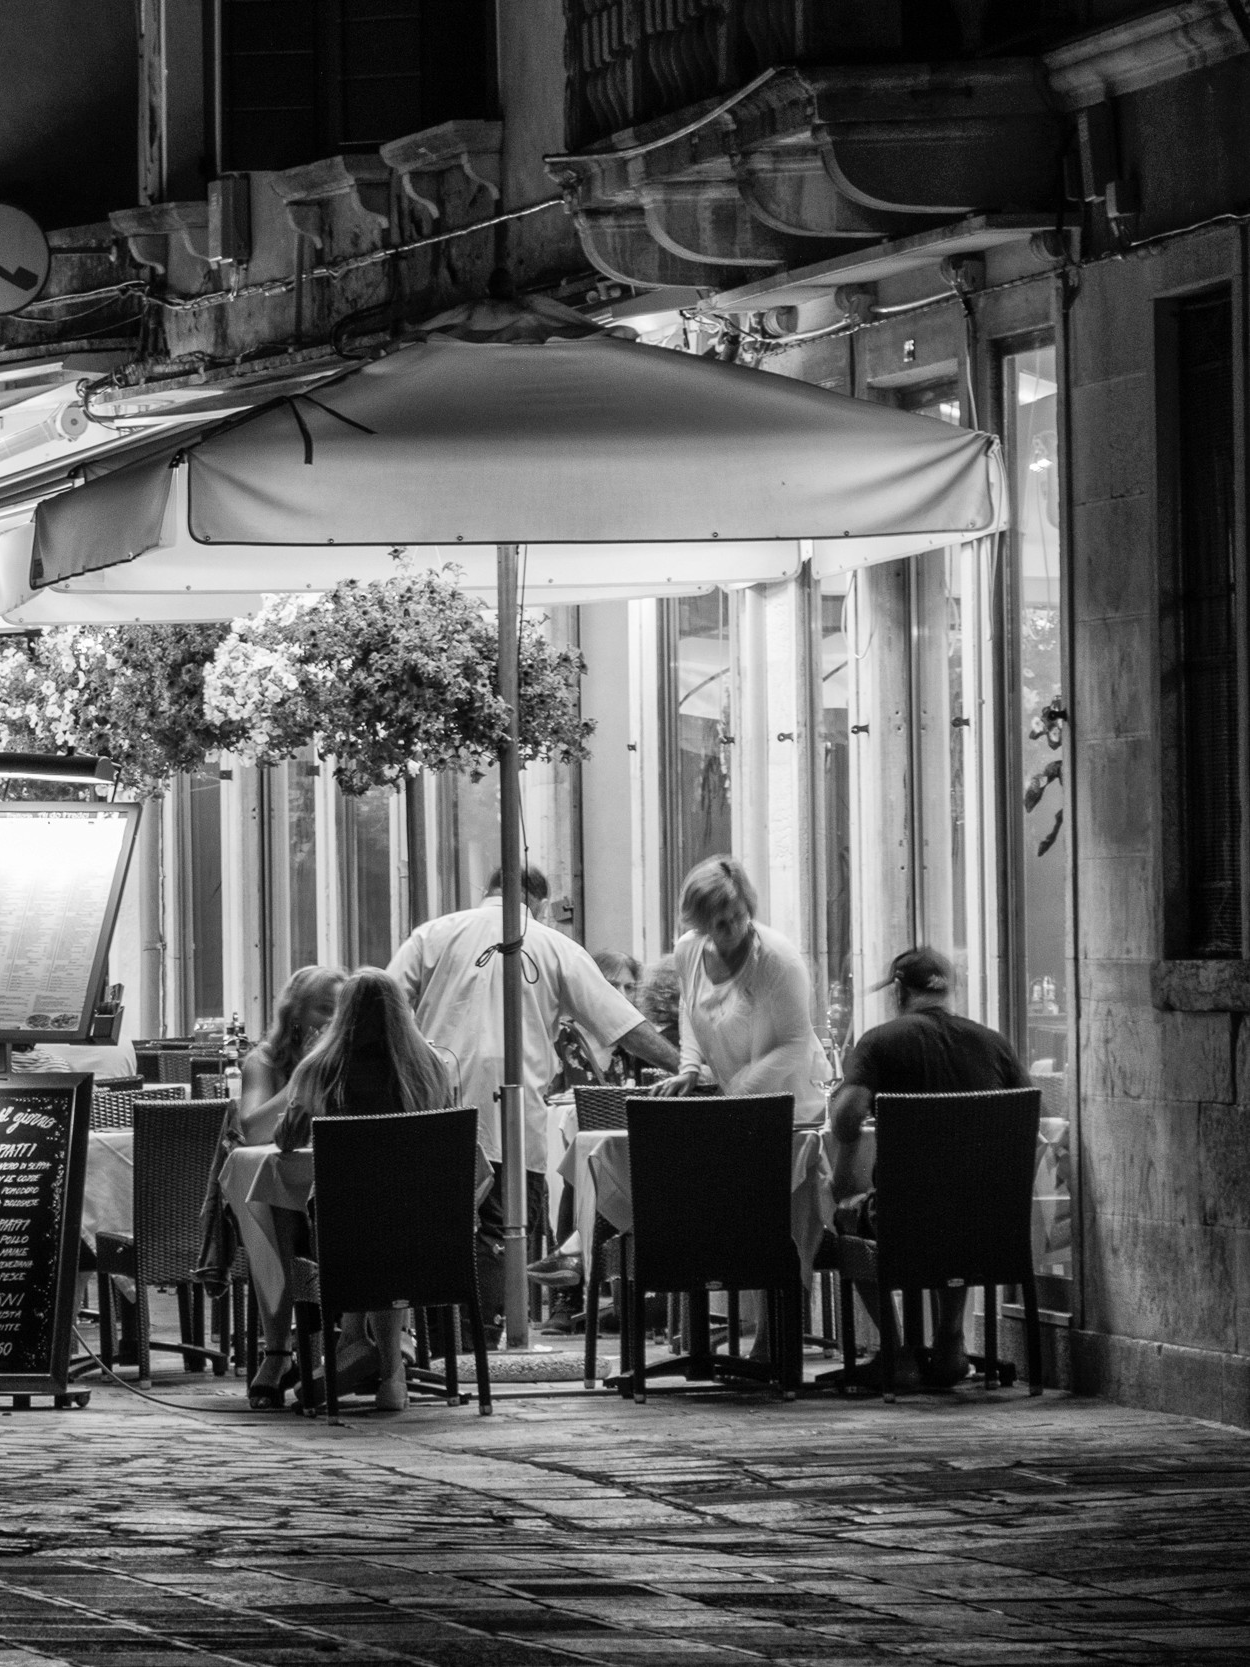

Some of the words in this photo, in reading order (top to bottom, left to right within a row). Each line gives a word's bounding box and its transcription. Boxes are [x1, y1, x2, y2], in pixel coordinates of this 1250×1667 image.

[6, 1108, 57, 1135] giorno
[3, 1174, 16, 1183] LE
[0, 1186, 40, 1195] POMODORO
[3, 1198, 40, 1208] BOLOGNESE
[0, 1235, 30, 1245] POLLO
[0, 1247, 30, 1257] MAIALE
